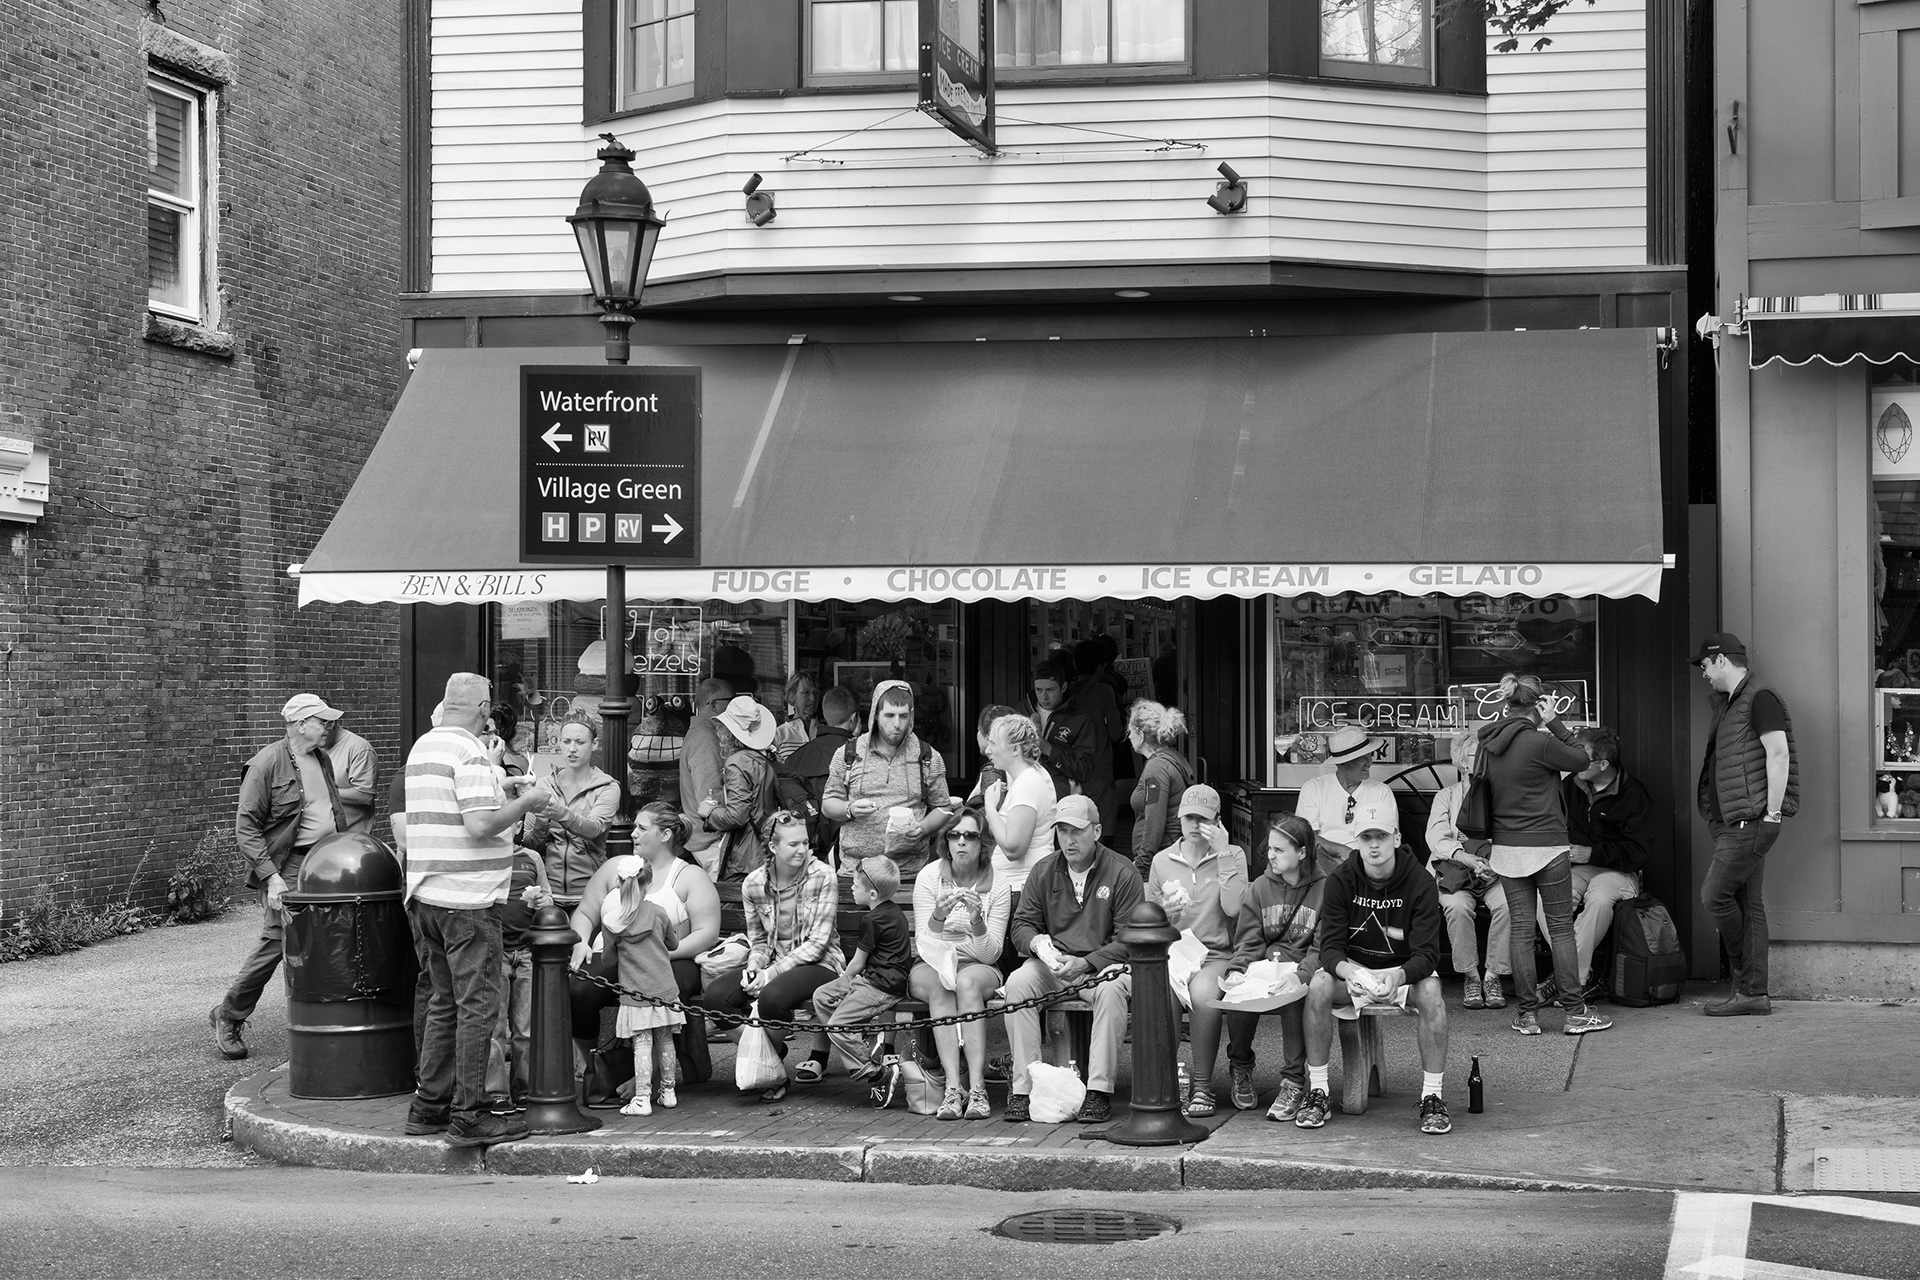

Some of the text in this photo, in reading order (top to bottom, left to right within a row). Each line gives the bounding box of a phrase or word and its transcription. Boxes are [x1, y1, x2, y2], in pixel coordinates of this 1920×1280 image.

[540, 390, 658, 412] Waterfront
[588, 431, 607, 446] RV
[538, 477, 682, 504] Village Green
[547, 516, 640, 538] H P RV
[400, 574, 547, 596] BEN & BILL'S
[711, 565, 1543, 593] FUDGE CHOCOLATE ICE CREAM GELATO
[625, 610, 680, 642] Hot
[633, 643, 699, 672] etzels
[1127, 675, 1147, 686] OUR
[1306, 701, 1458, 728] ICE CREAM
[1474, 688, 1577, 722] Geto
[1186, 791, 1208, 805] Ohio
[1371, 898, 1403, 909] FLOYD
